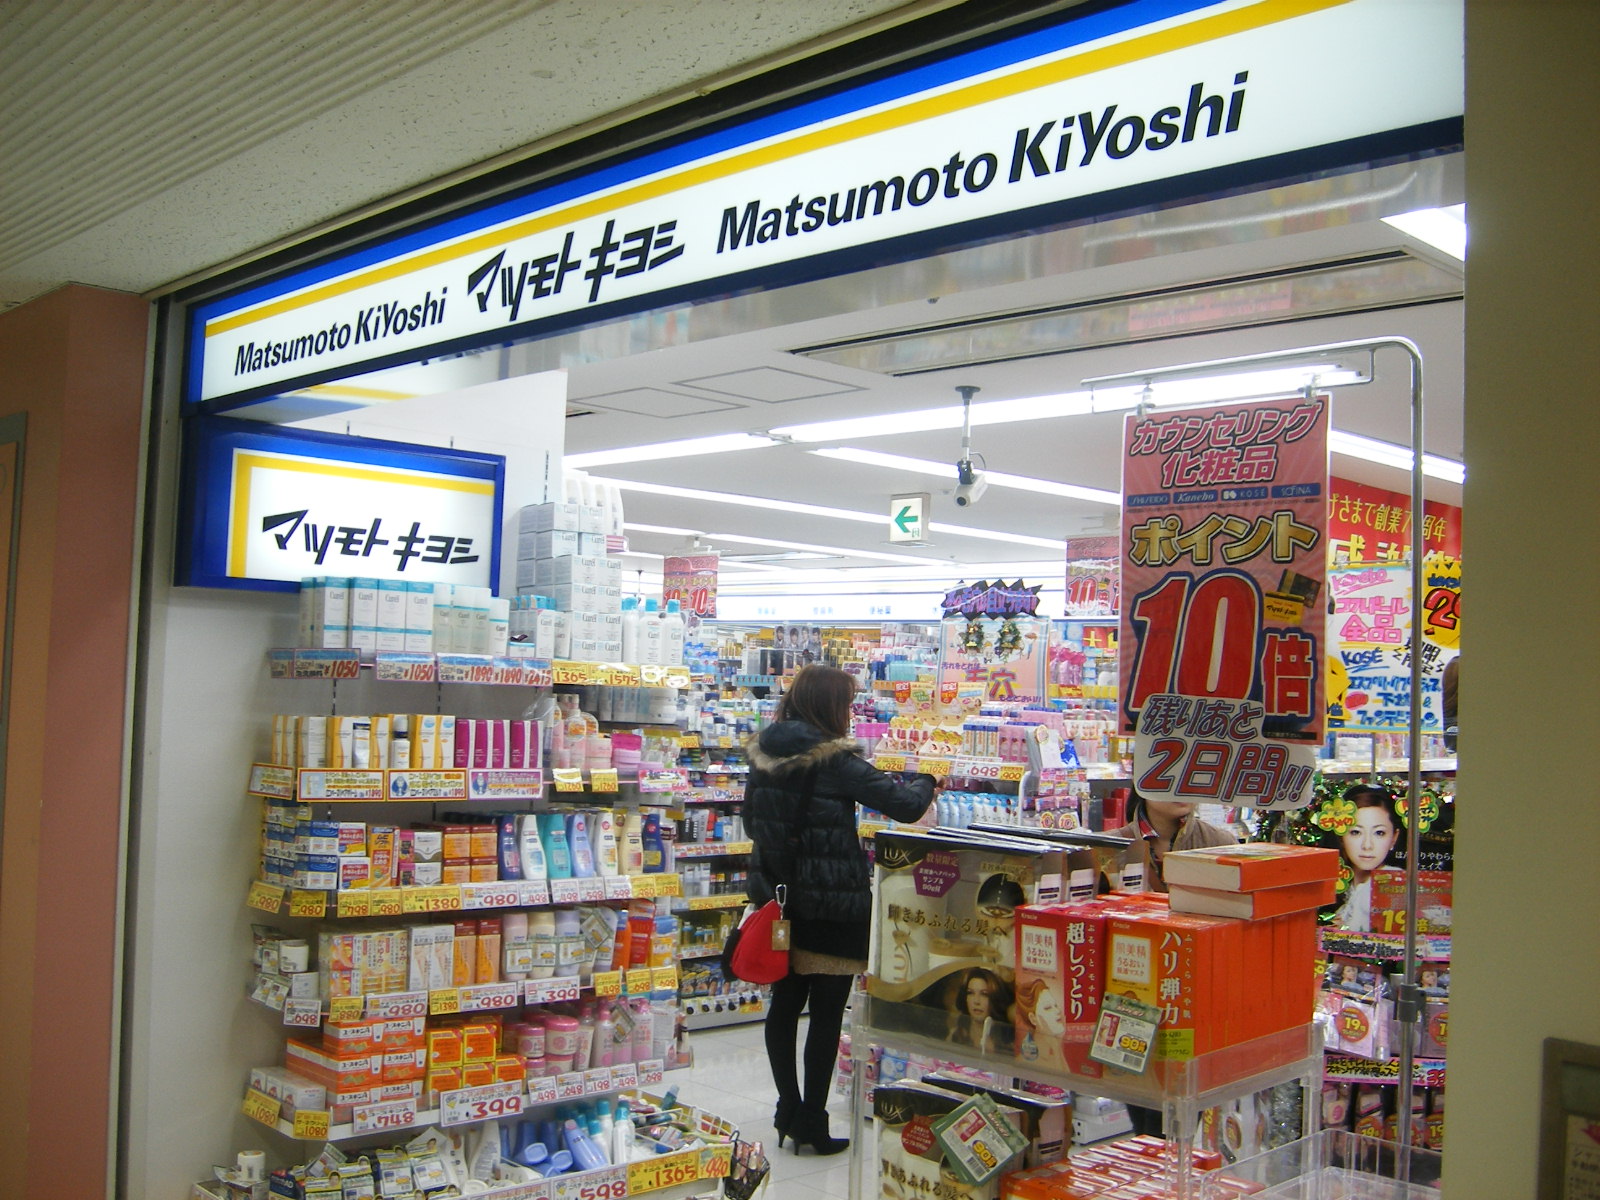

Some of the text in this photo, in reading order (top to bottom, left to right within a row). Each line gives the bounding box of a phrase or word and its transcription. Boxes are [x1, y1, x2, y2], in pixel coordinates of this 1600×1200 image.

[716, 71, 1249, 254] Matsumoto KiYoshi
[467, 219, 685, 321] マツモトキヨシ
[235, 287, 448, 376] Matsumoto KiYoshi
[1130, 402, 1323, 455] カウンセリング
[1162, 444, 1278, 488] 化粧品
[262, 509, 480, 572] マツモトキヨシ
[1129, 511, 1319, 567] ポイント
[1340, 613, 1402, 643] 全品
[1143, 696, 1264, 742] 残りあと
[883, 847, 911, 864] LUX
[483, 893, 518, 906] 980
[1065, 922, 1086, 1021] 超しっとり
[1159, 931, 1183, 1026] ハリ弾力
[388, 1003, 425, 1016] 980
[481, 995, 515, 1008] 980
[545, 988, 578, 1003] 399
[471, 1096, 522, 1119] 399
